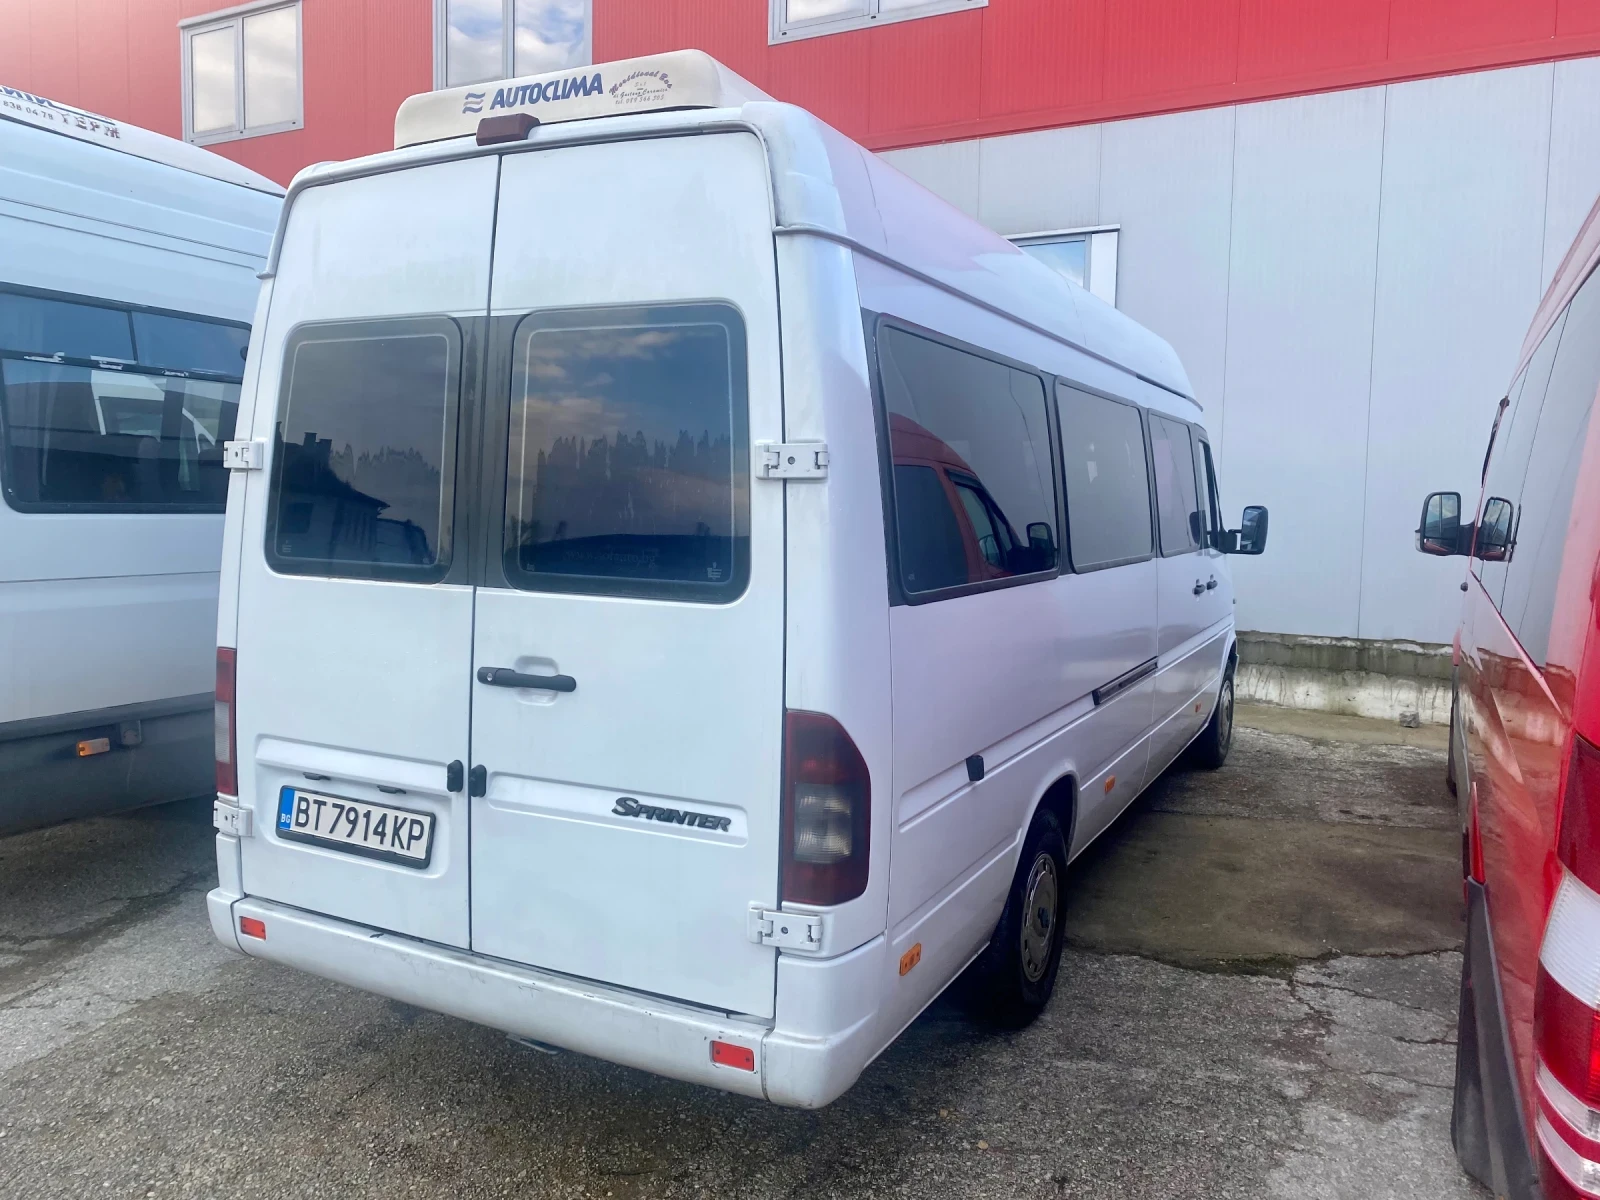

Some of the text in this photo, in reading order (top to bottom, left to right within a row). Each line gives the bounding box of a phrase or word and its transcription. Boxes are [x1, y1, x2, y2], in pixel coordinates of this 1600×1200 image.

[489, 72, 604, 110] AUTOCLIMA
[280, 813, 291, 824] BG
[611, 796, 732, 833] SPRINTER
